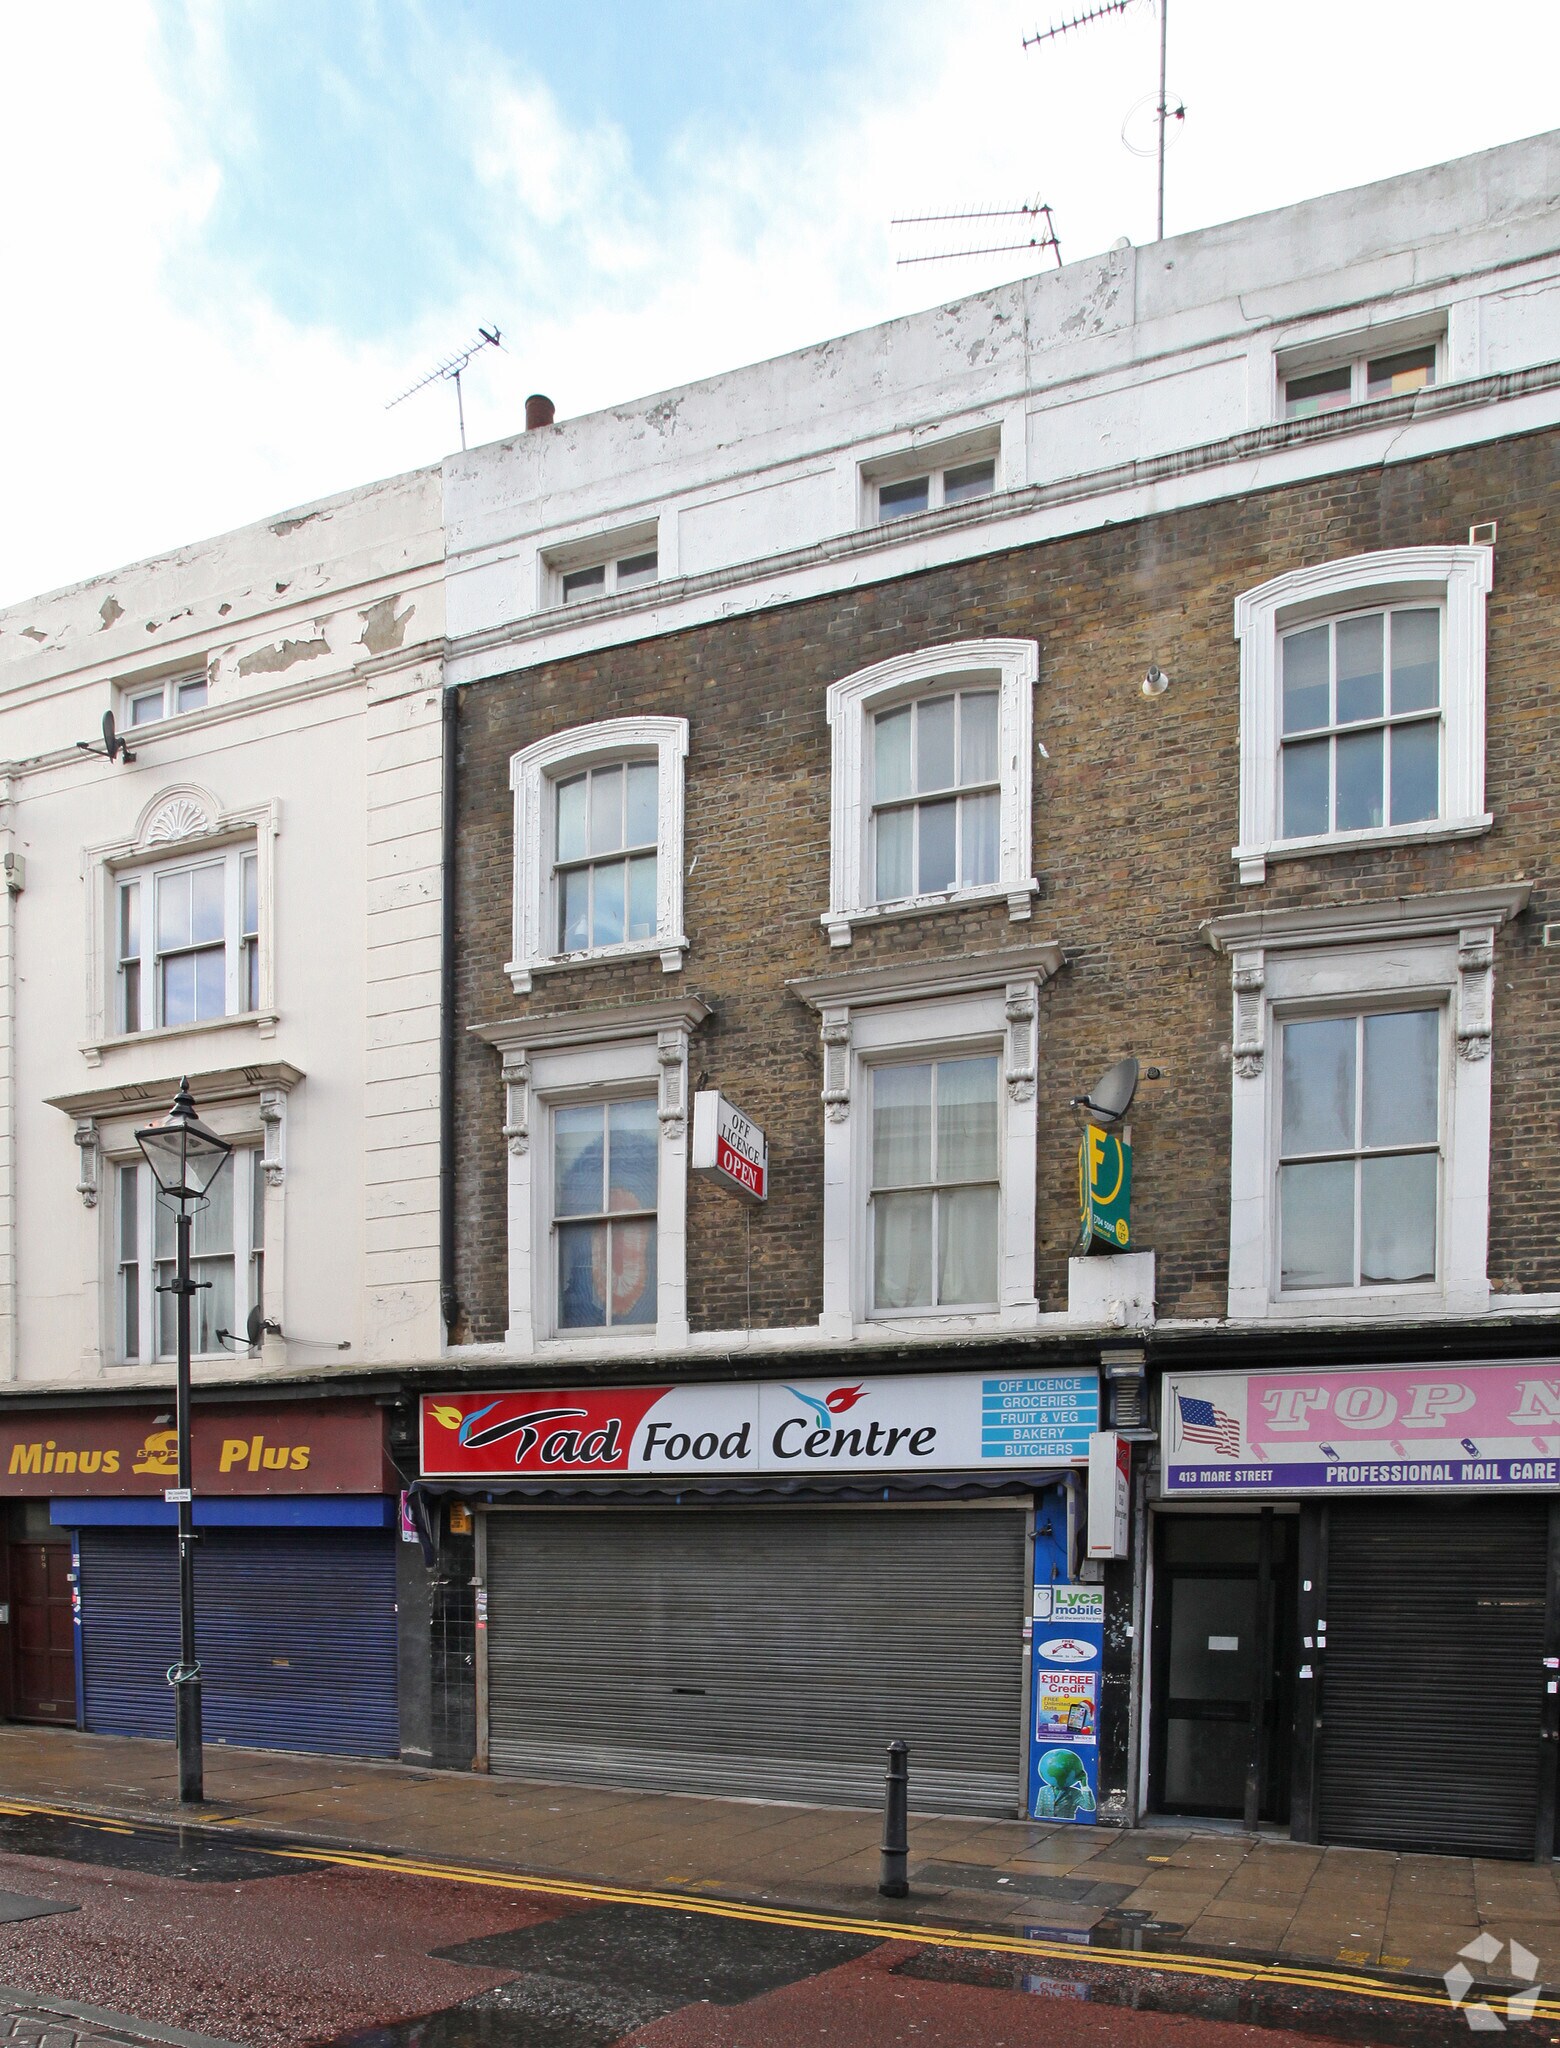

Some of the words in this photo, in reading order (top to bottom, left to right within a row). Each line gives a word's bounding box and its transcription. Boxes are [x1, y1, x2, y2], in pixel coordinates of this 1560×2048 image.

[732, 1114, 751, 1138] OFF
[722, 1123, 760, 1165] LICENCE
[723, 1150, 757, 1190] OPEN
[1119, 1222, 1126, 1231] TO
[1118, 1231, 1126, 1241] LET
[999, 1381, 1024, 1392] OFF
[1027, 1378, 1081, 1391] LICENCE
[1003, 1395, 1077, 1408] GROCERIES
[1259, 1380, 1476, 1432] TOP
[1000, 1412, 1037, 1424] FRUIT
[1040, 1412, 1051, 1424] &
[1053, 1411, 1079, 1423] VEG
[464, 1408, 622, 1464] Tad
[642, 1422, 751, 1461] Food
[772, 1418, 937, 1459] Centre
[1013, 1428, 1065, 1440] BAKERY
[7, 1440, 120, 1475] Minus
[219, 1436, 310, 1473] Plus
[1004, 1443, 1073, 1456] BUTCHERS
[1178, 1472, 1197, 1483] 413
[1200, 1471, 1231, 1482] MARE
[1234, 1470, 1273, 1482] STREET
[1326, 1464, 1453, 1482] PROFESSIONAL
[1461, 1463, 1501, 1480] NAIL
[1510, 1462, 1556, 1479] CARE
[1056, 1590, 1102, 1606] Lyca
[1056, 1605, 1102, 1615] mobile
[1041, 1675, 1060, 1683] £10
[1062, 1675, 1093, 1684] FREE
[1049, 1684, 1085, 1693] Credit
